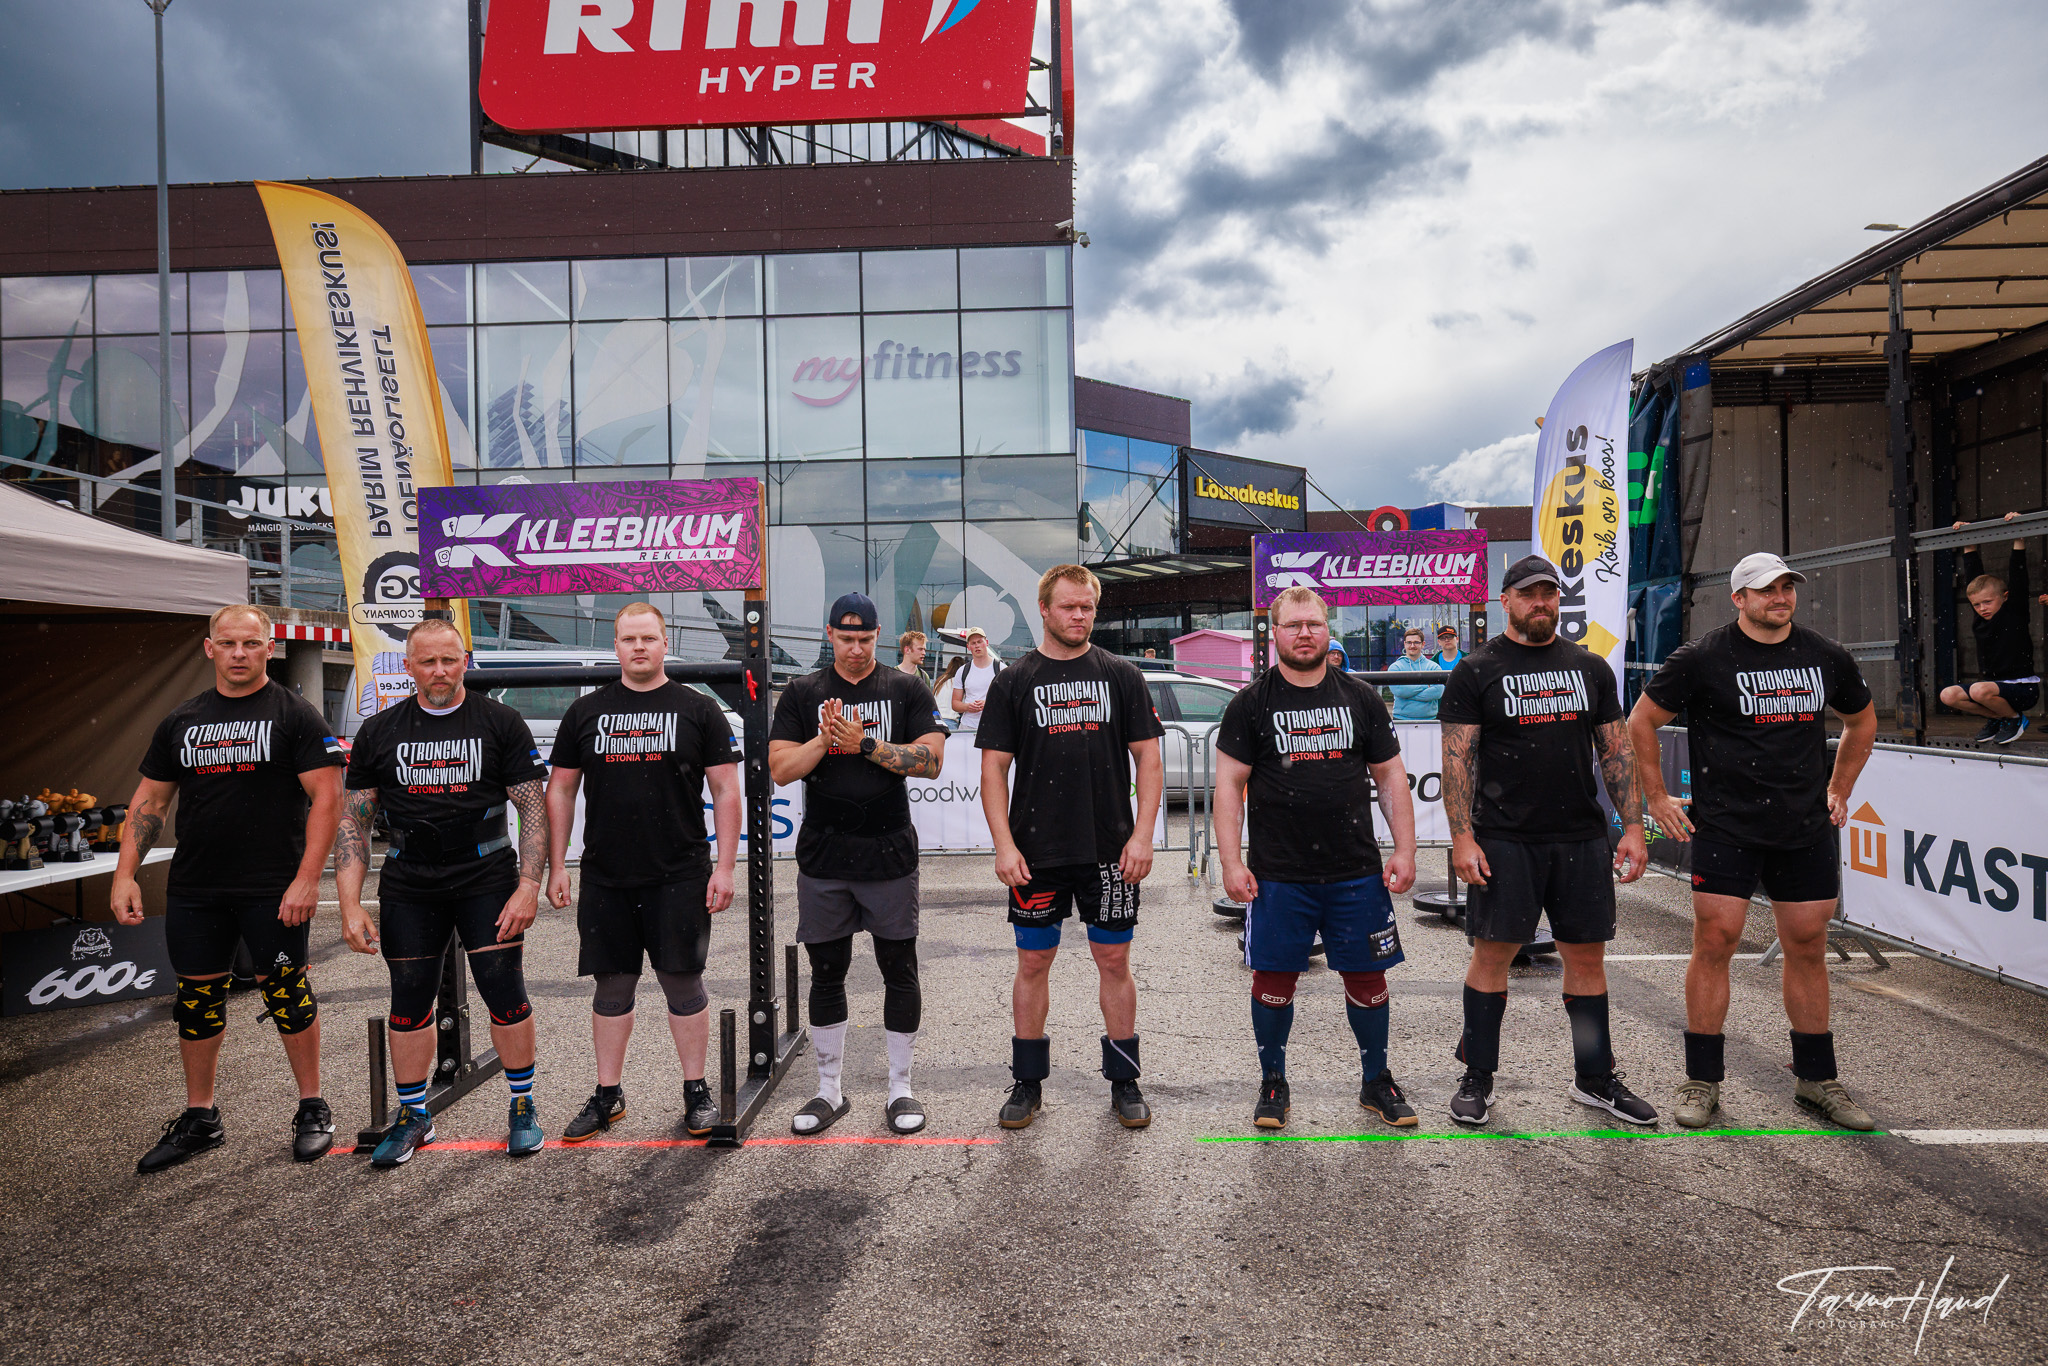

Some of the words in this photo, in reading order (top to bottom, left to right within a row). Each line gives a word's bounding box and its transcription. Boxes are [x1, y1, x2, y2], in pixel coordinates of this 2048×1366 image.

[699, 62, 876, 94] HYPER
[1593, 435, 1616, 491] koos!
[1194, 476, 1300, 510] Lõunakeskus
[1602, 496, 1617, 524] on
[247, 523, 292, 532] MÄNGIDS
[516, 513, 743, 551] KLEEBIKUM
[1556, 424, 1588, 651] akeskus
[638, 550, 728, 561] REKLAAM
[1320, 553, 1477, 578] KLEEBIKUM
[1593, 529, 1621, 583] Kõik
[1405, 577, 1466, 585] REKLAAM
[1502, 670, 1589, 695] STRONGMAN
[1736, 666, 1824, 693] STRONGMAN
[1034, 681, 1111, 705] STRONGMAN
[1539, 690, 1554, 698] PRO
[1776, 688, 1792, 697] PRO
[1034, 703, 1111, 727] STRONGWOMAN
[1067, 700, 1080, 708] PRO
[1502, 693, 1589, 717] STRONGWOMAN
[1736, 692, 1824, 716] STRONGWOMAN
[594, 713, 678, 734] STRONGMAN
[1048, 723, 1082, 735] ESTONIA
[1084, 722, 1099, 731] 2026
[1273, 706, 1354, 732] STRONGMAN
[1519, 714, 1557, 725] ESTONIA
[1560, 712, 1577, 721] 2026
[1754, 713, 1794, 724] ESTONIA
[1798, 713, 1814, 722] 2026
[180, 721, 272, 745] STRONGMAN
[629, 730, 643, 738] PRO
[1273, 730, 1354, 754] STRONGWOMAN
[1308, 727, 1322, 736] PRO
[217, 740, 233, 748] PRO
[396, 738, 482, 764] STRONGMAN
[594, 734, 678, 754] STRONGWOMAN
[180, 743, 272, 768] STRONGWOMAN
[431, 760, 446, 768] PRO
[605, 754, 641, 763] ESTONIA
[645, 753, 662, 761] 2026
[1289, 752, 1325, 762] ESTONIA
[195, 765, 232, 775] ESTONIA
[236, 763, 255, 773] 2026
[396, 763, 482, 785] STRONGWOMAN
[408, 785, 444, 794] ESTONIA
[449, 784, 468, 793] 2026
[909, 780, 979, 802] oodw
[25, 961, 157, 1005] 600€
